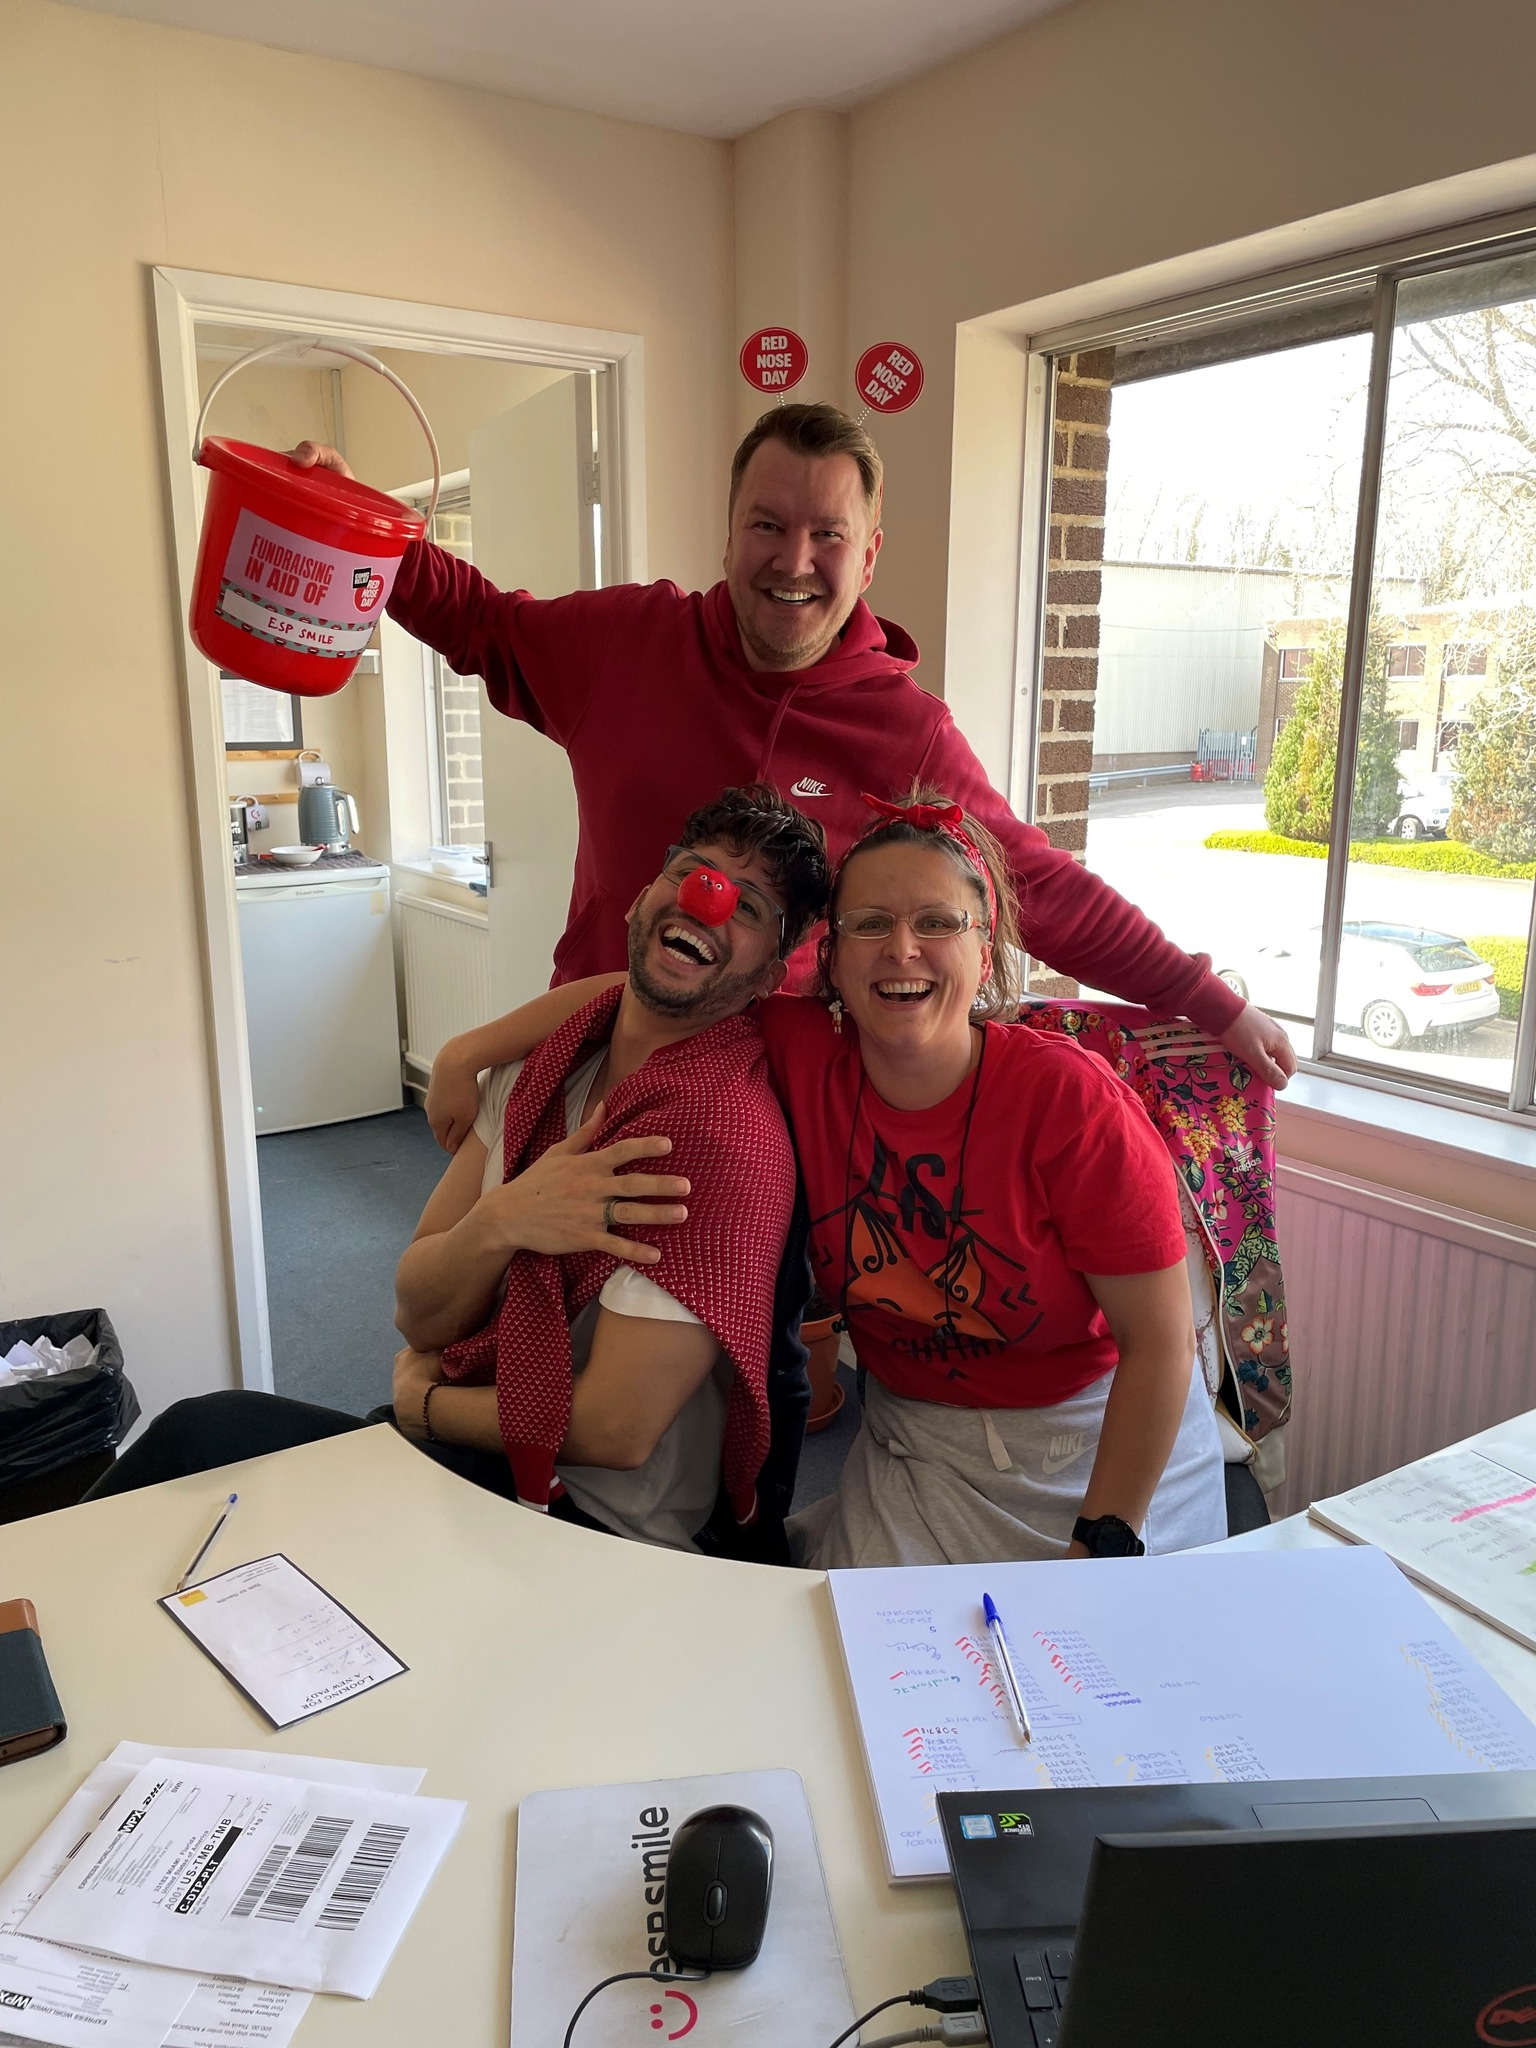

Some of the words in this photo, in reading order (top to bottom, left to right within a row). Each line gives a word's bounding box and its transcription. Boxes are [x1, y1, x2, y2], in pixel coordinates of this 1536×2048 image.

[761, 335, 788, 350] RED
[756, 353, 792, 368] NOSE
[886, 350, 914, 377] RED
[761, 370, 788, 386] DAY
[871, 361, 907, 395] NOSE
[864, 379, 893, 406] DAY
[250, 534, 335, 586] FUNDRAISING
[244, 555, 265, 582] IN
[266, 572, 299, 598] AID
[303, 581, 328, 606] OF
[367, 580, 380, 589] RED
[361, 588, 379, 598] NOSE
[360, 597, 375, 607] DAY
[268, 616, 293, 634] ESP
[299, 628, 334, 645] SMILE
[799, 776, 827, 794] NIKE
[1050, 1432, 1088, 1457] NIKE
[324, 1675, 374, 1701] LOOKING
[332, 1677, 353, 1690] NEW
[305, 1688, 330, 1702] PAD?
[301, 1698, 322, 1710] FOR
[78, 1865, 99, 1889] EXPRESS
[97, 1833, 123, 1865] WORLDWIDE
[119, 1810, 145, 1833] WPX
[142, 1782, 165, 1806] DHL
[180, 1836, 197, 1856] Florida
[161, 1876, 175, 1894] United
[174, 1859, 188, 1876] States
[191, 1830, 209, 1852] America
[165, 1886, 185, 1910] A001
[180, 1818, 232, 1885] US-TMB-TMB
[179, 1859, 220, 1912] C-DTP-PLT
[0, 1991, 31, 2010] WPX
[267, 1990, 292, 1998] Address
[28, 2003, 74, 2019] WORLDWIDE
[217, 1999, 237, 2007] Shirley
[73, 2014, 108, 2026] EXPRESS
[230, 2008, 255, 2016] Address
[255, 2009, 280, 2018] Delivery
[224, 2029, 235, 2037] this
[231, 2022, 249, 2030] Thank
[236, 2029, 249, 2037] ship
